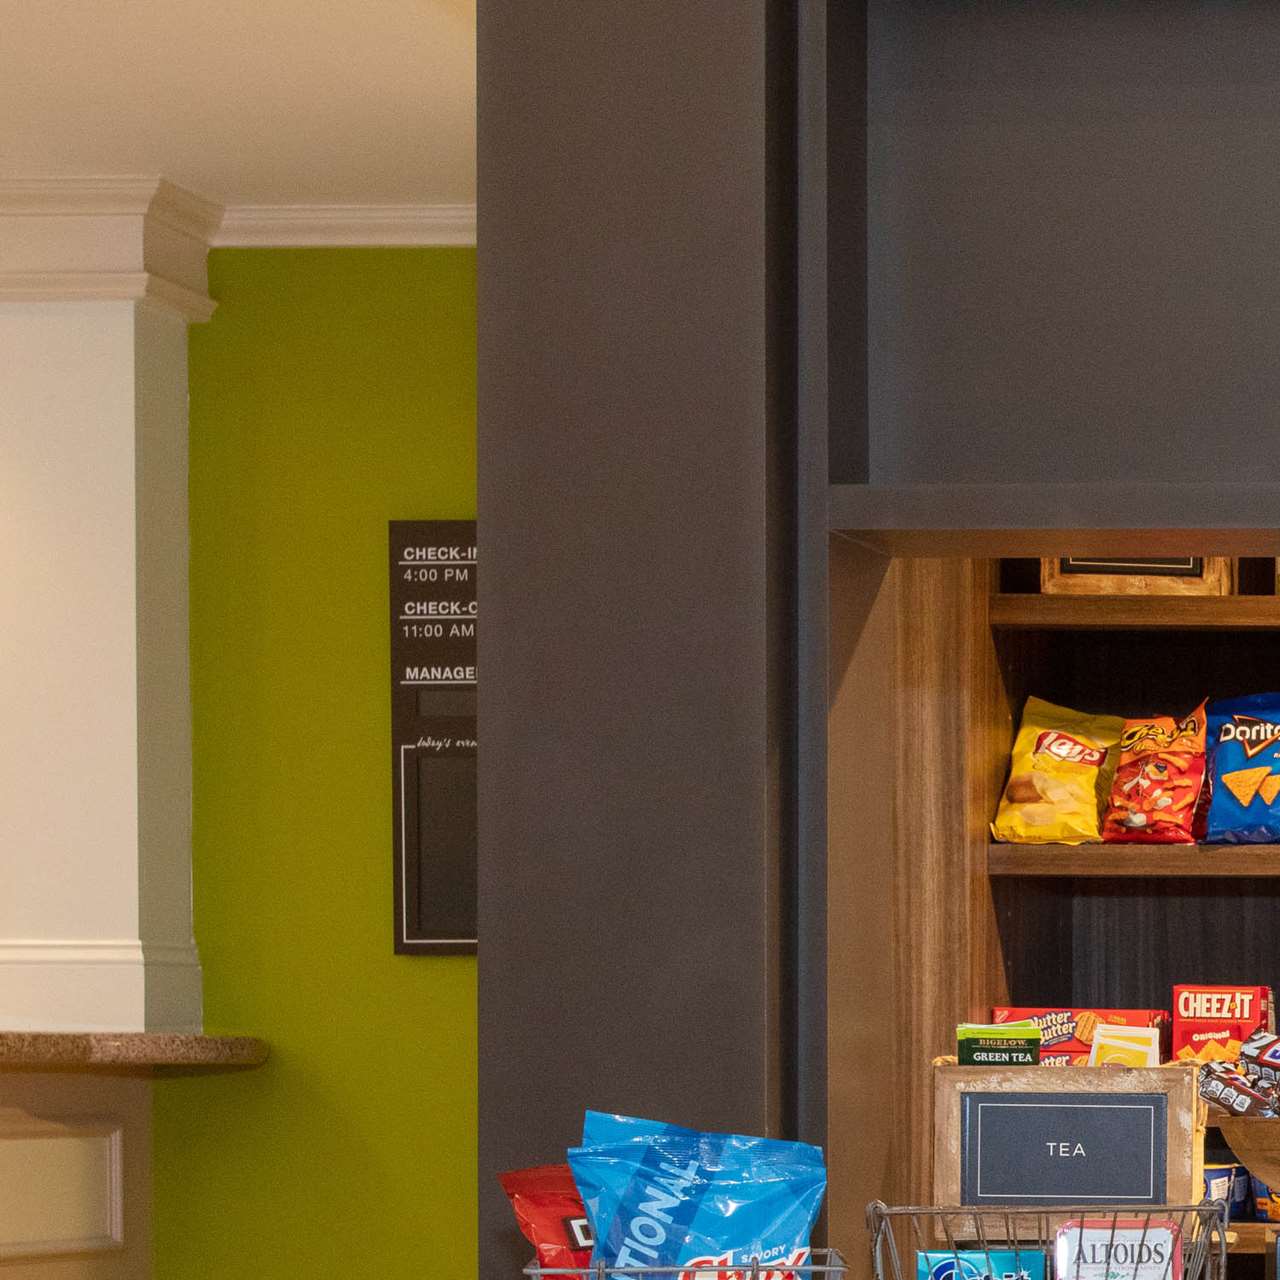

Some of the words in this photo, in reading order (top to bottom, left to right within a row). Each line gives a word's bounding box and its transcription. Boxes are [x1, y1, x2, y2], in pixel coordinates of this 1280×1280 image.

[403, 568, 438, 582] 4:00
[444, 568, 469, 581] PM
[402, 624, 443, 638] 11:00
[449, 623, 475, 637] AM
[405, 667, 478, 680] MANAGE
[978, 1038, 1026, 1047] BIGELOW
[973, 1051, 1010, 1063] GREEN
[1011, 1052, 1033, 1063] TEA
[1046, 1142, 1087, 1157] TEA
[1073, 1242, 1165, 1265] ALTOIDS
